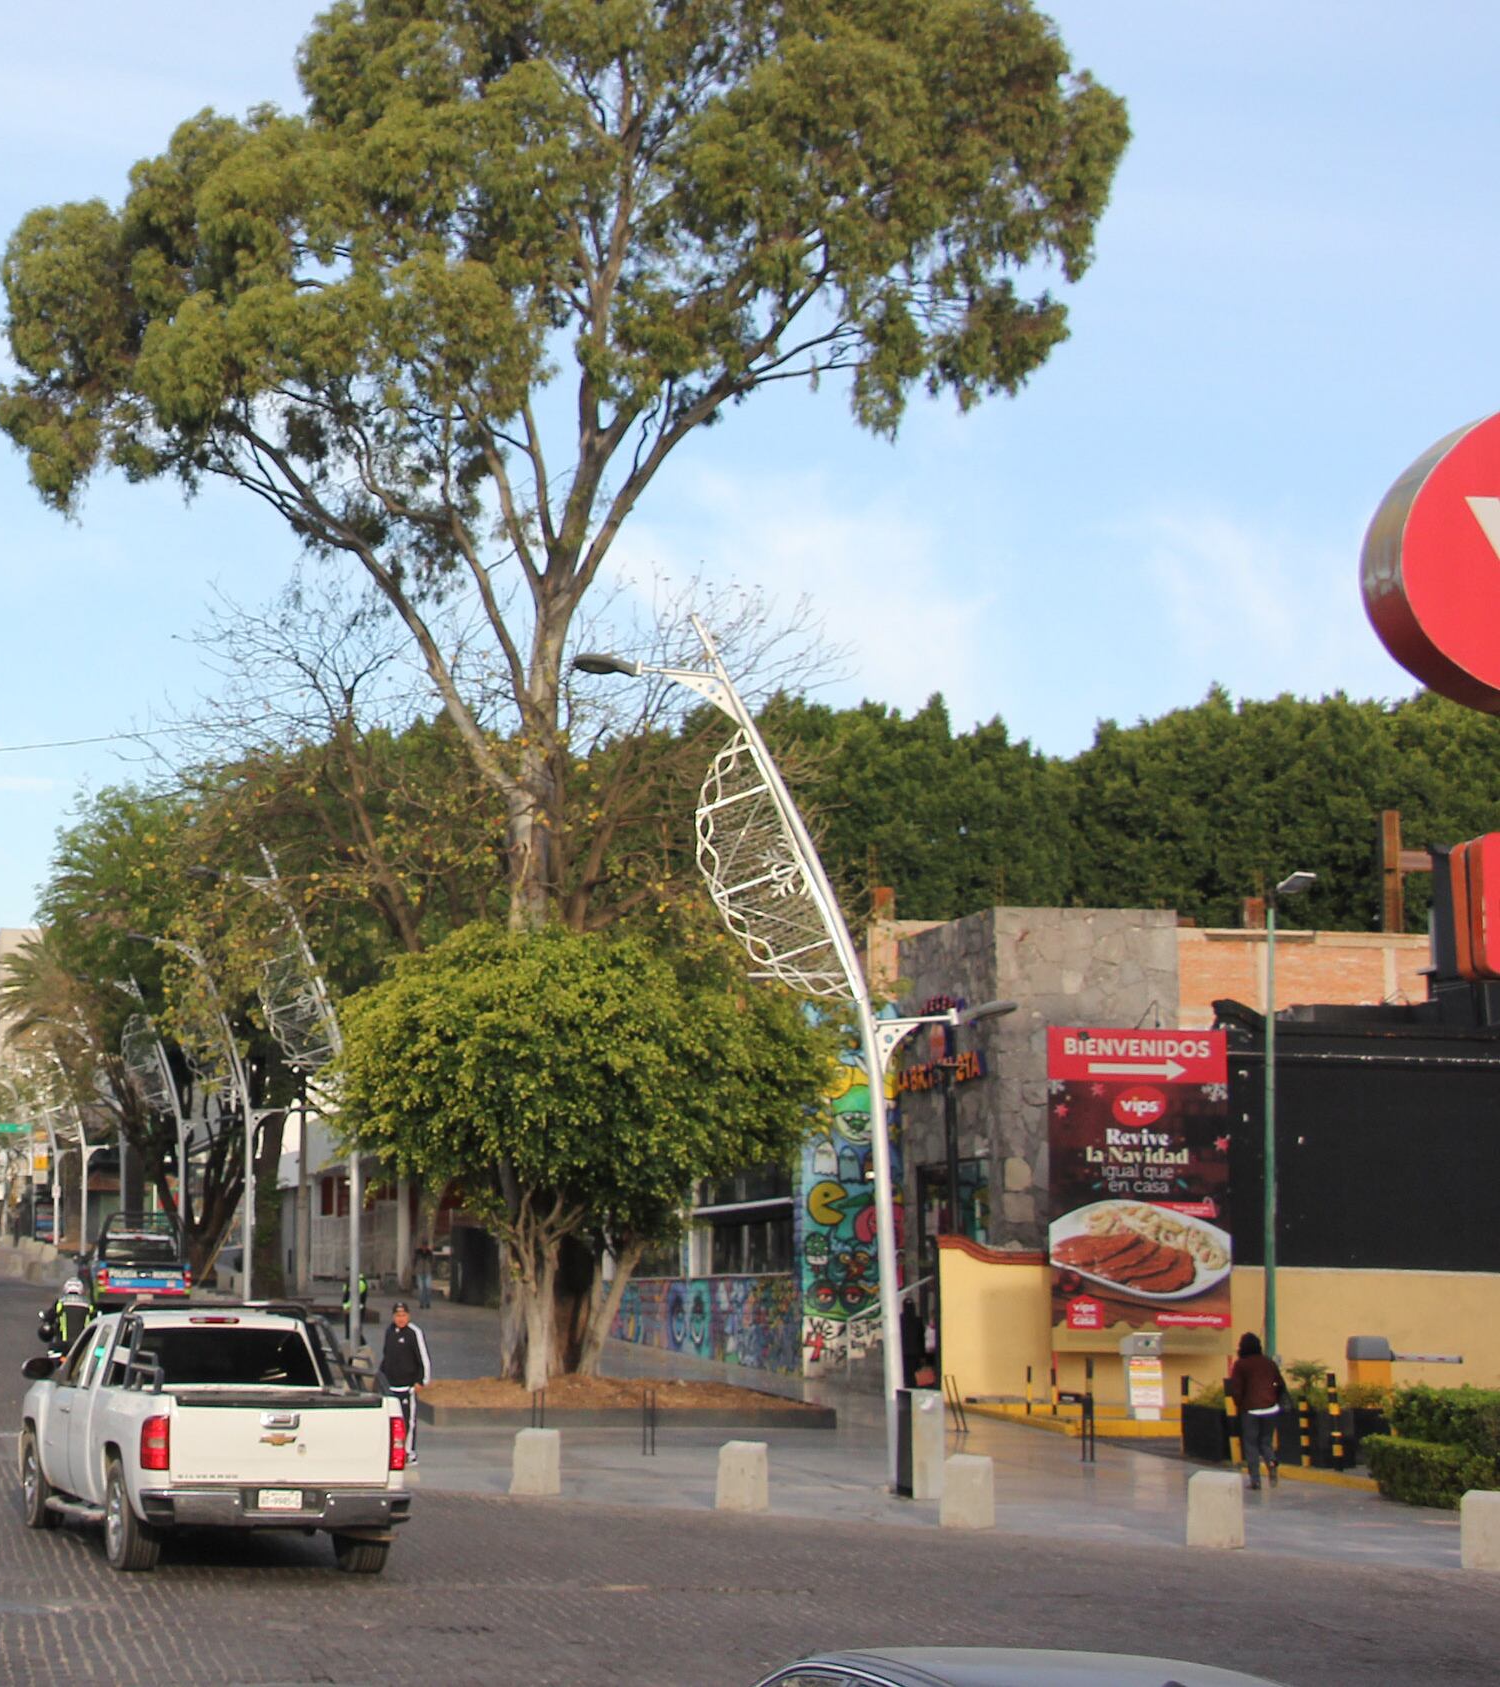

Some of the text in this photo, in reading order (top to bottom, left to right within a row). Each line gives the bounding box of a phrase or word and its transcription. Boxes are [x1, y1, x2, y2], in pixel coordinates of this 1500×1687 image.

[1064, 1038, 1210, 1058] BIENVENIDOS
[1120, 1096, 1159, 1117] vips
[1106, 1128, 1169, 1146] Revive
[1085, 1146, 1189, 1164] la Navidad
[1101, 1163, 1174, 1180] igual que
[1108, 1181, 1169, 1193] en casa
